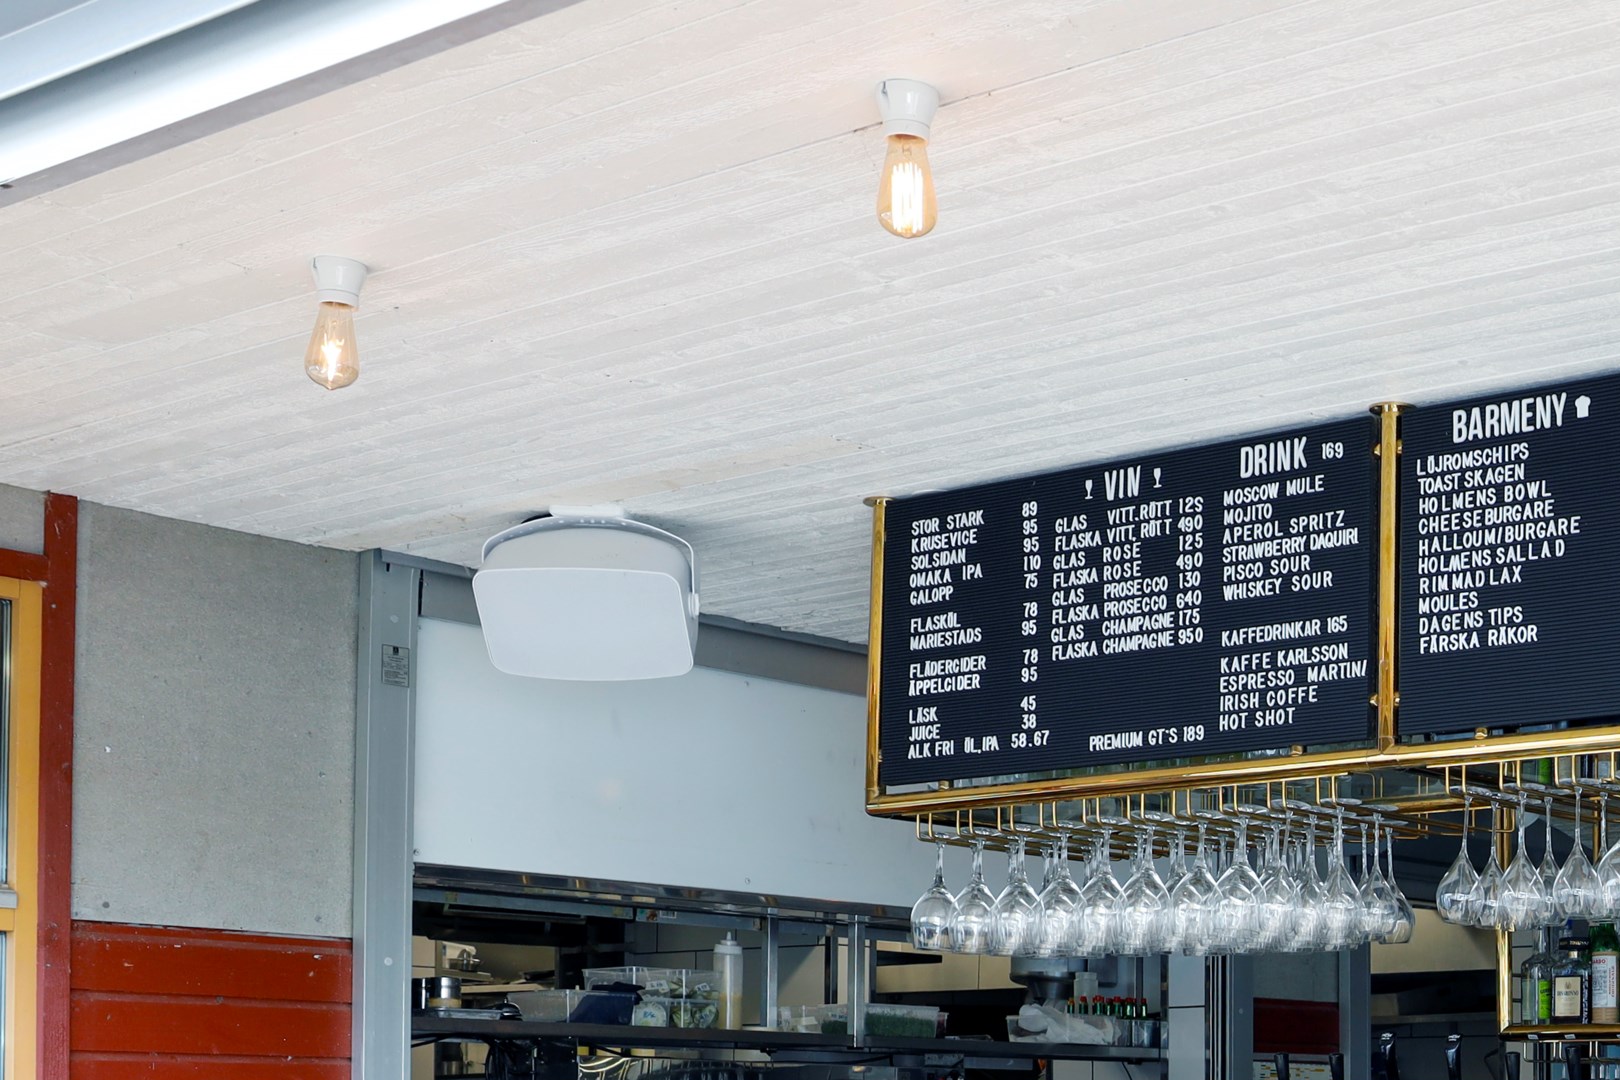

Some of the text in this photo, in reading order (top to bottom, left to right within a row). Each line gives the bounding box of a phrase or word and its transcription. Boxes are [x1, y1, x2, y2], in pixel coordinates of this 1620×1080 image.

[1452, 392, 1567, 444] BARMENY
[1240, 436, 1344, 479] DRINK 169
[1104, 465, 1141, 501] VIN
[1223, 475, 1325, 507] MOSCOW MULE
[1418, 472, 1461, 495] TOAST
[1464, 463, 1525, 488] SKAGEN
[1419, 488, 1497, 515] HOLMENS
[1504, 480, 1552, 503] BOWL
[911, 501, 1038, 536] STOR STARK 89
[1055, 514, 1088, 534] GLAS
[1222, 510, 1345, 545] APEROL SPRITZ
[1224, 503, 1273, 526] MOJITO
[911, 519, 1038, 553] KRUSEVICE 95
[1054, 530, 1102, 552] FLASKA
[1177, 514, 1203, 533] 490
[1222, 535, 1307, 563] STRAWBERRY
[911, 536, 1039, 570] SOLSIDAN 95
[1053, 551, 1086, 570] GLAS
[1179, 533, 1203, 552] 125
[1418, 549, 1491, 574] HOLMENS
[1495, 539, 1565, 564] SALLAD
[909, 555, 1041, 588] OMAKA IPA 110
[1053, 552, 1203, 589] FLASKA ROSE 490
[1223, 554, 1311, 582] PISCO SOUR
[1490, 565, 1522, 585] LAX
[910, 572, 1038, 606] GALOPP 75
[1052, 571, 1201, 607] GLAS PROSECCO 130
[1223, 571, 1333, 601] WHISKEY SOUR
[910, 601, 1038, 633] FLASKÖL 78
[1052, 590, 1202, 625] FLASKA PROSECCO 640
[1418, 591, 1478, 614] MOULES
[910, 619, 1037, 651] MARIESTADS 95
[1051, 608, 1200, 643] GLAS CHAMPAGNE 175
[1221, 615, 1348, 647] KAFFEDRINKAR 165
[1418, 611, 1483, 635] DAGENS
[1488, 606, 1522, 626] TIPS
[1023, 648, 1038, 665] 78
[1052, 627, 1203, 661] FLASKA CHAMPAGNE 950
[1220, 643, 1348, 674] KAFFE KARLSSON
[1021, 667, 1038, 683] 95
[1220, 669, 1295, 693] ESPRESSO
[1020, 695, 1036, 711] 45
[1220, 685, 1318, 712] IRISH COFFE
[909, 714, 1037, 741] JUICE 38
[1219, 708, 1296, 732] HOT SHOT
[907, 742, 931, 760] ALK
[935, 740, 954, 757] FRI
[1089, 731, 1143, 752] PREMIUM
[1183, 725, 1205, 742] 189
